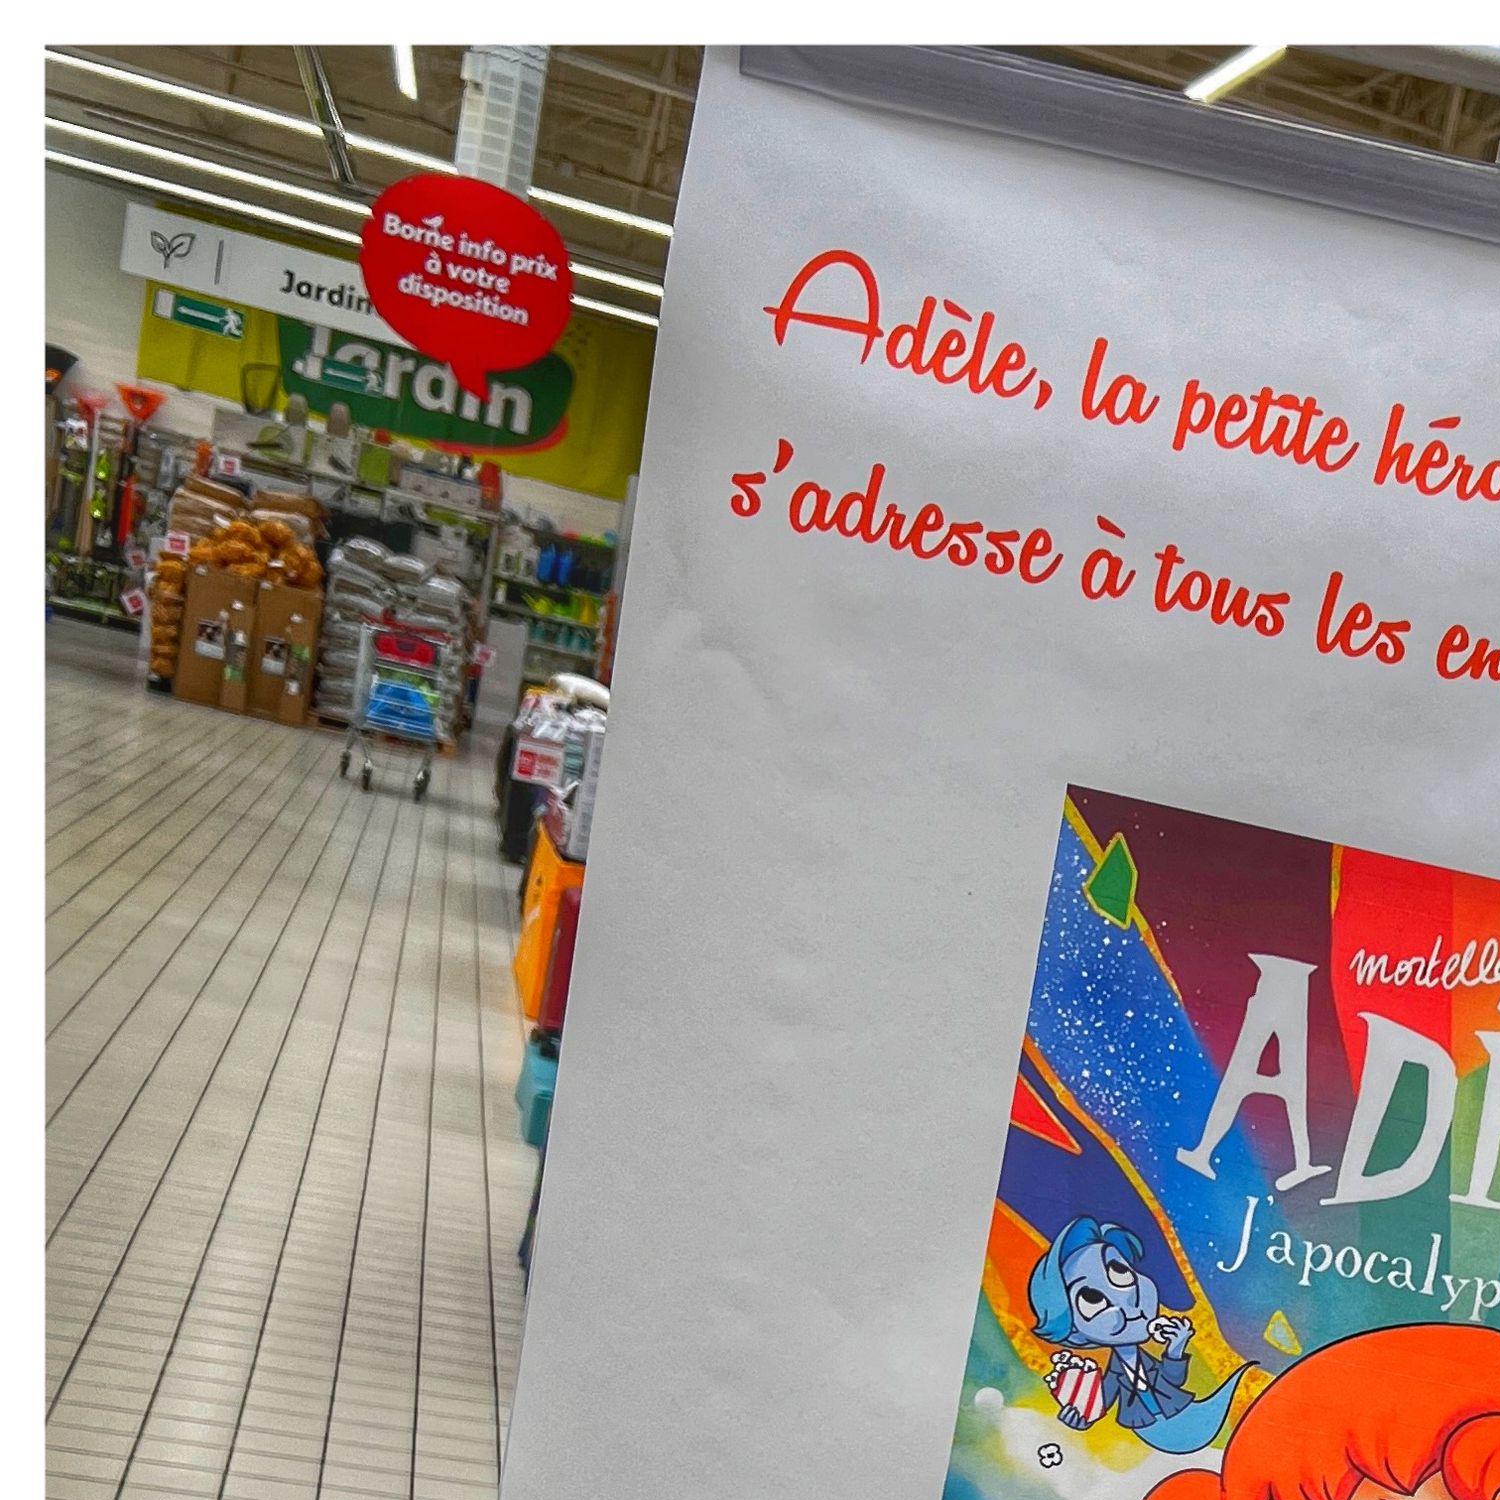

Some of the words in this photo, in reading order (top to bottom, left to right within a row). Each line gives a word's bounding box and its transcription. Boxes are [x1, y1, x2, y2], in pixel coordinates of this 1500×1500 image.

[382, 212, 453, 251] Borne
[457, 232, 507, 265] info
[509, 253, 557, 281] prix
[424, 250, 442, 275] à
[446, 261, 511, 293] votre
[398, 273, 529, 326] disposition
[762, 249, 1053, 411] Adèle,
[1081, 336, 1160, 425] la
[1173, 379, 1359, 473] petite
[731, 437, 1064, 584] s'adresse
[1081, 514, 1137, 600] à
[1154, 544, 1291, 634] tous
[1317, 571, 1412, 665] les
